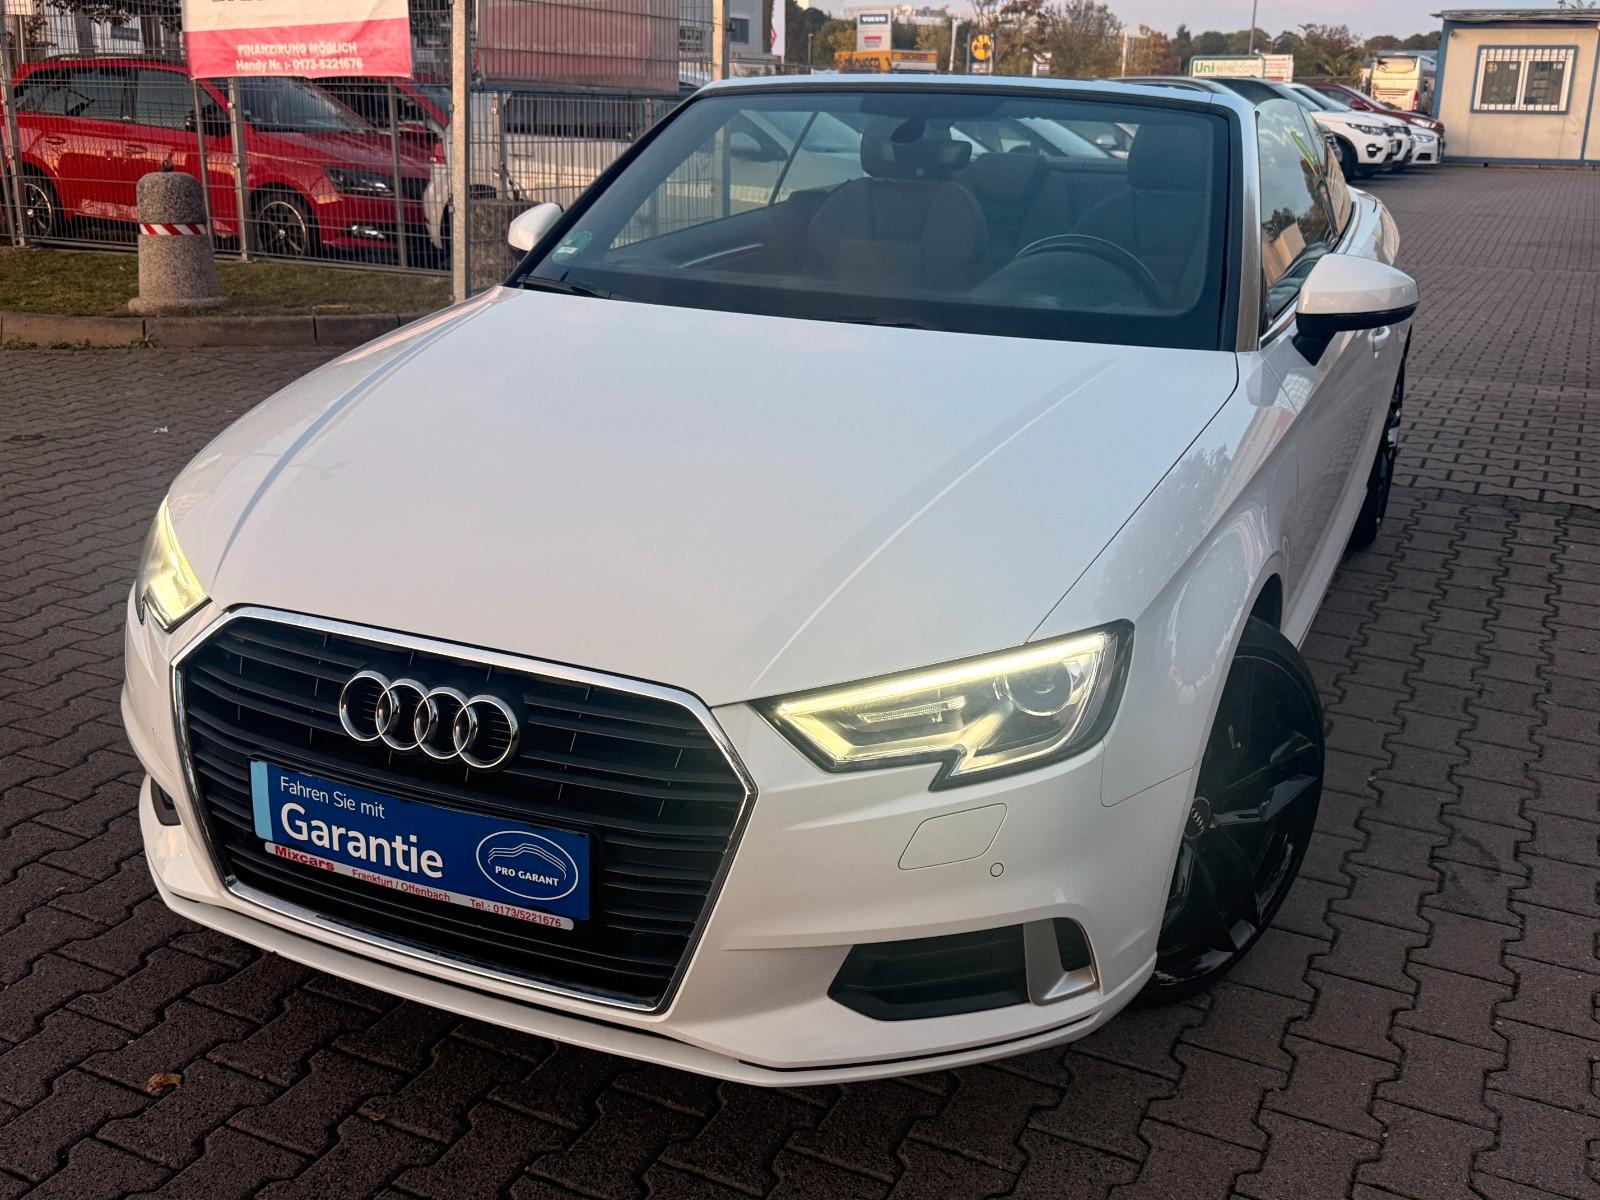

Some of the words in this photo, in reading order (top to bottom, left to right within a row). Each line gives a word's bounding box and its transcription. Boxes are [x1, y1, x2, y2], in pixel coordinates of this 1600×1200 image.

[308, 41, 357, 54] MÖGLICH
[236, 59, 266, 72] Handy
[280, 775, 329, 804] Fahren
[333, 791, 356, 811] Sie
[360, 801, 386, 819] mit
[281, 802, 443, 878] Garantie
[274, 845, 335, 872] Mixcars
[352, 868, 393, 887] Frankfurt
[400, 882, 451, 902] Offenbach
[493, 904, 562, 928] 0173/5221676
[495, 865, 516, 877] PRO
[517, 870, 559, 886] GARANT
